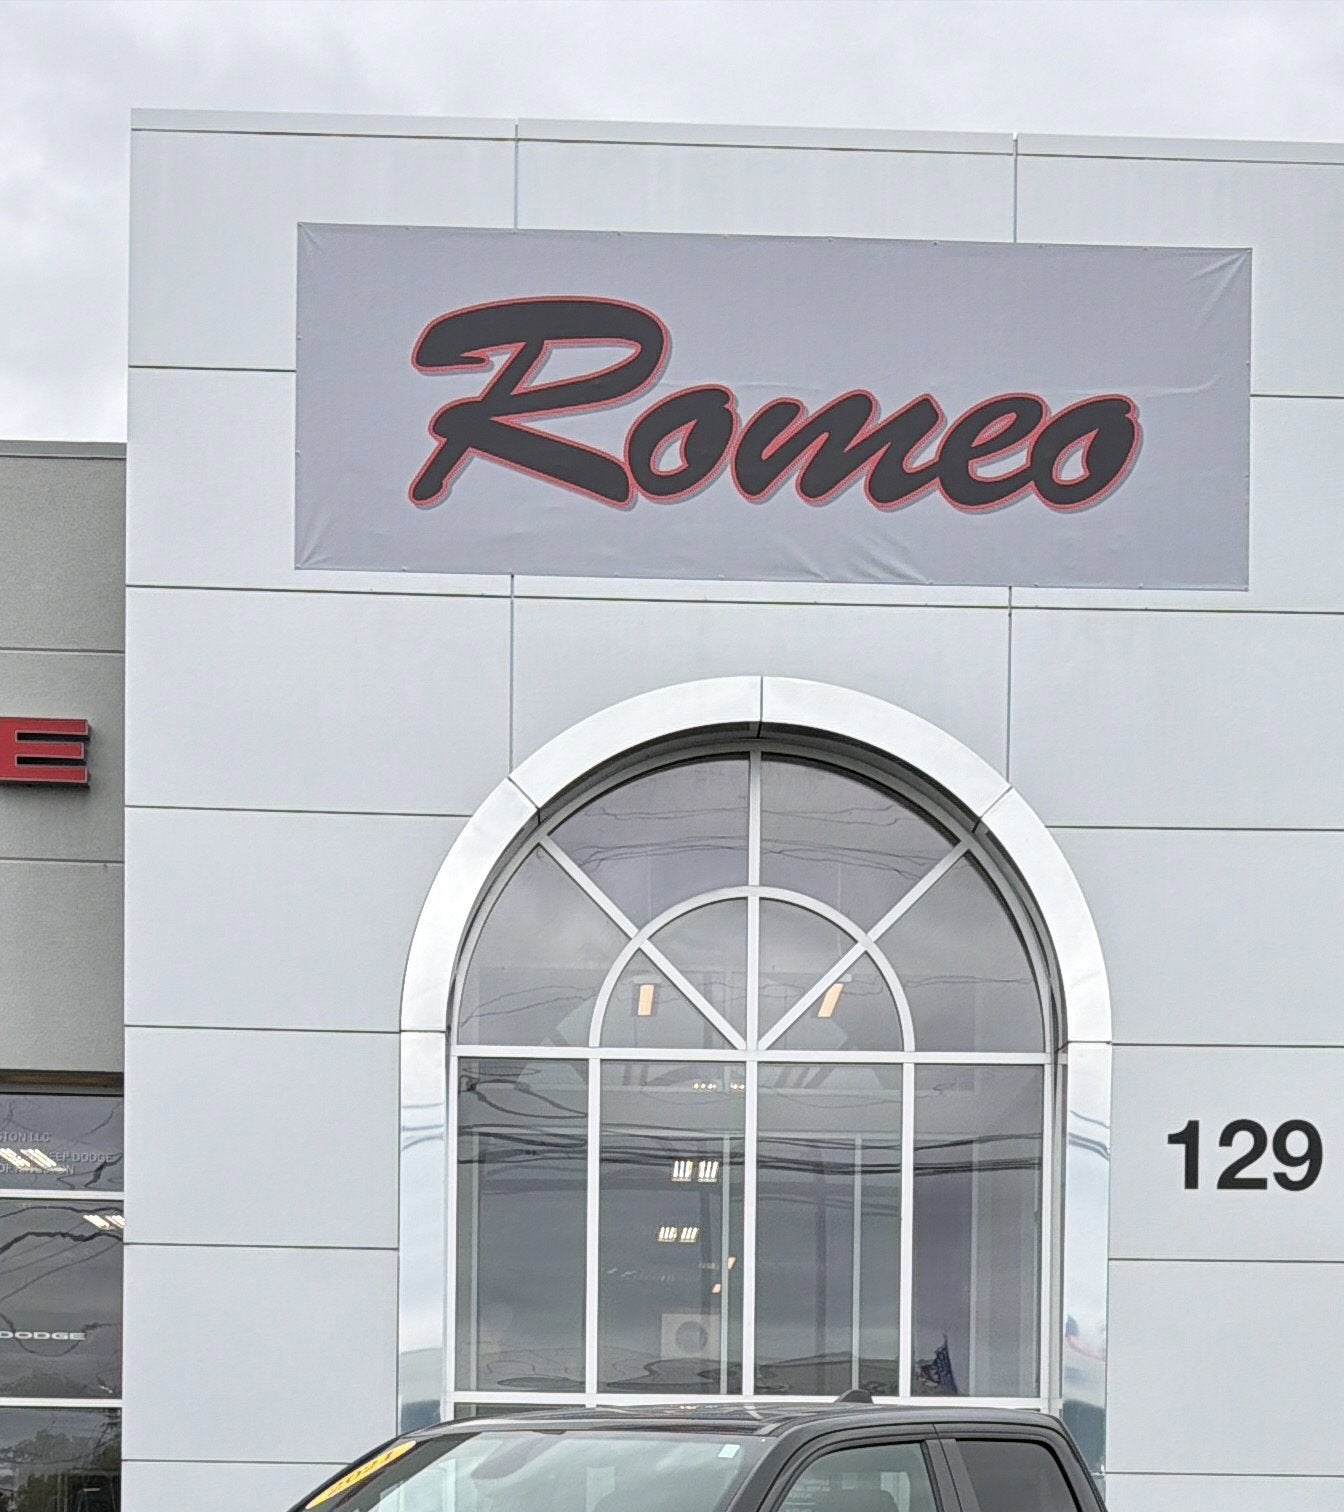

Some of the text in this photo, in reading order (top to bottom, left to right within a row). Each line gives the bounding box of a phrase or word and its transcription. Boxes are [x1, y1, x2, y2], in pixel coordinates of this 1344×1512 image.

[408, 295, 1146, 513] Romeo
[29, 1131, 52, 1143] LLC
[72, 1152, 114, 1163] DODGE
[1167, 1118, 1323, 1191] 129
